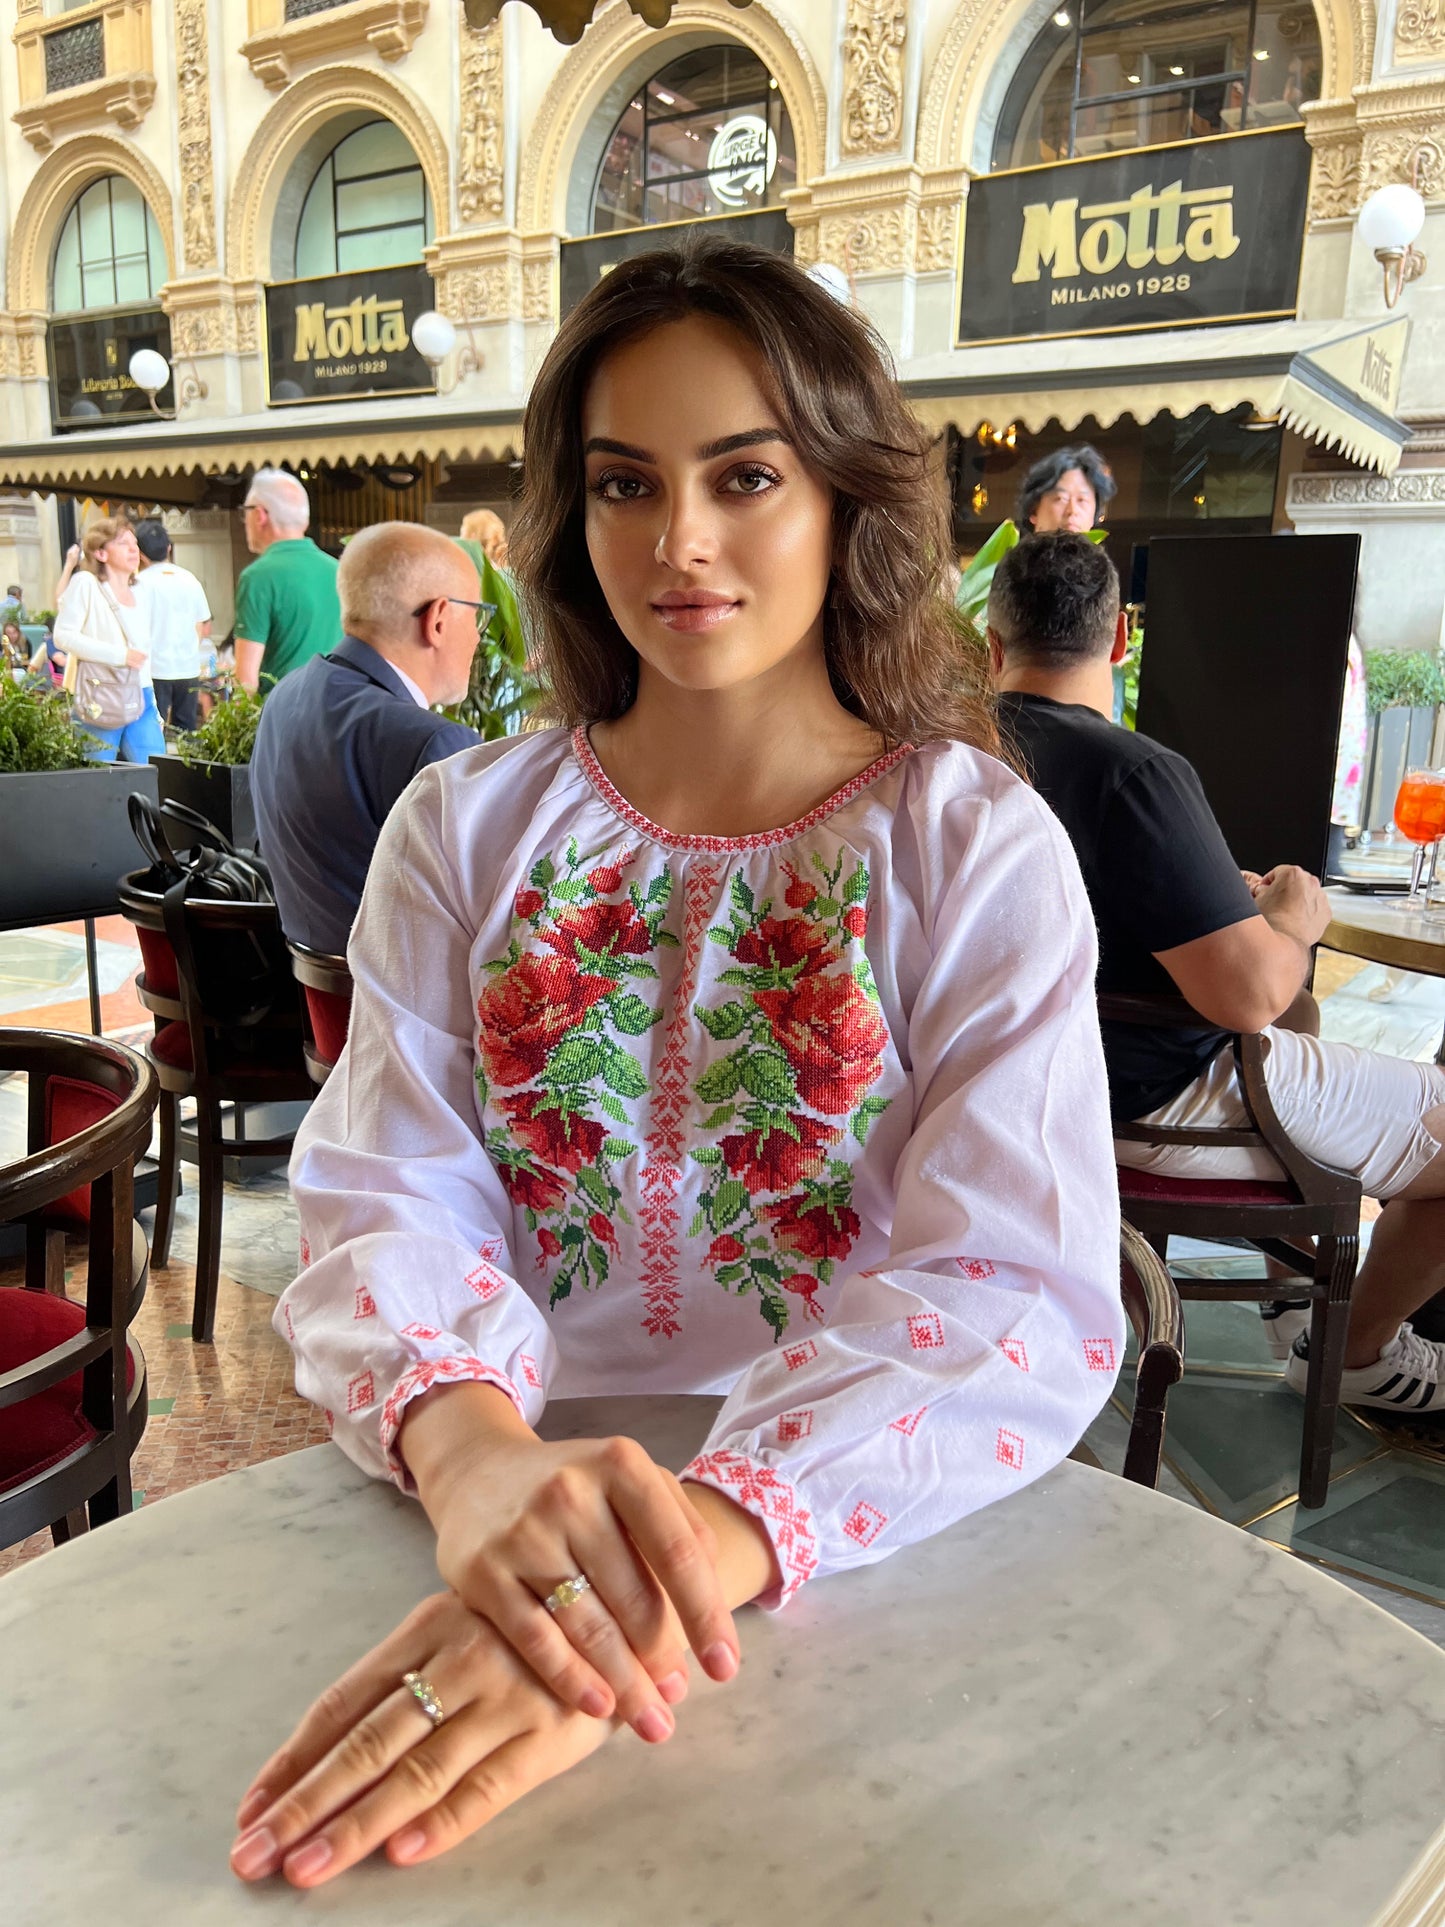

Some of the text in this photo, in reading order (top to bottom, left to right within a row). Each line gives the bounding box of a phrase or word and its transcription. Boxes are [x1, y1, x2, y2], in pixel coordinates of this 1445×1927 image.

[1011, 179, 1240, 284] Motta
[1051, 274, 1191, 306] MILANO 1928
[293, 293, 410, 362] Motta
[314, 359, 388, 379] MILANO 1928
[1360, 336, 1393, 401] Motta
